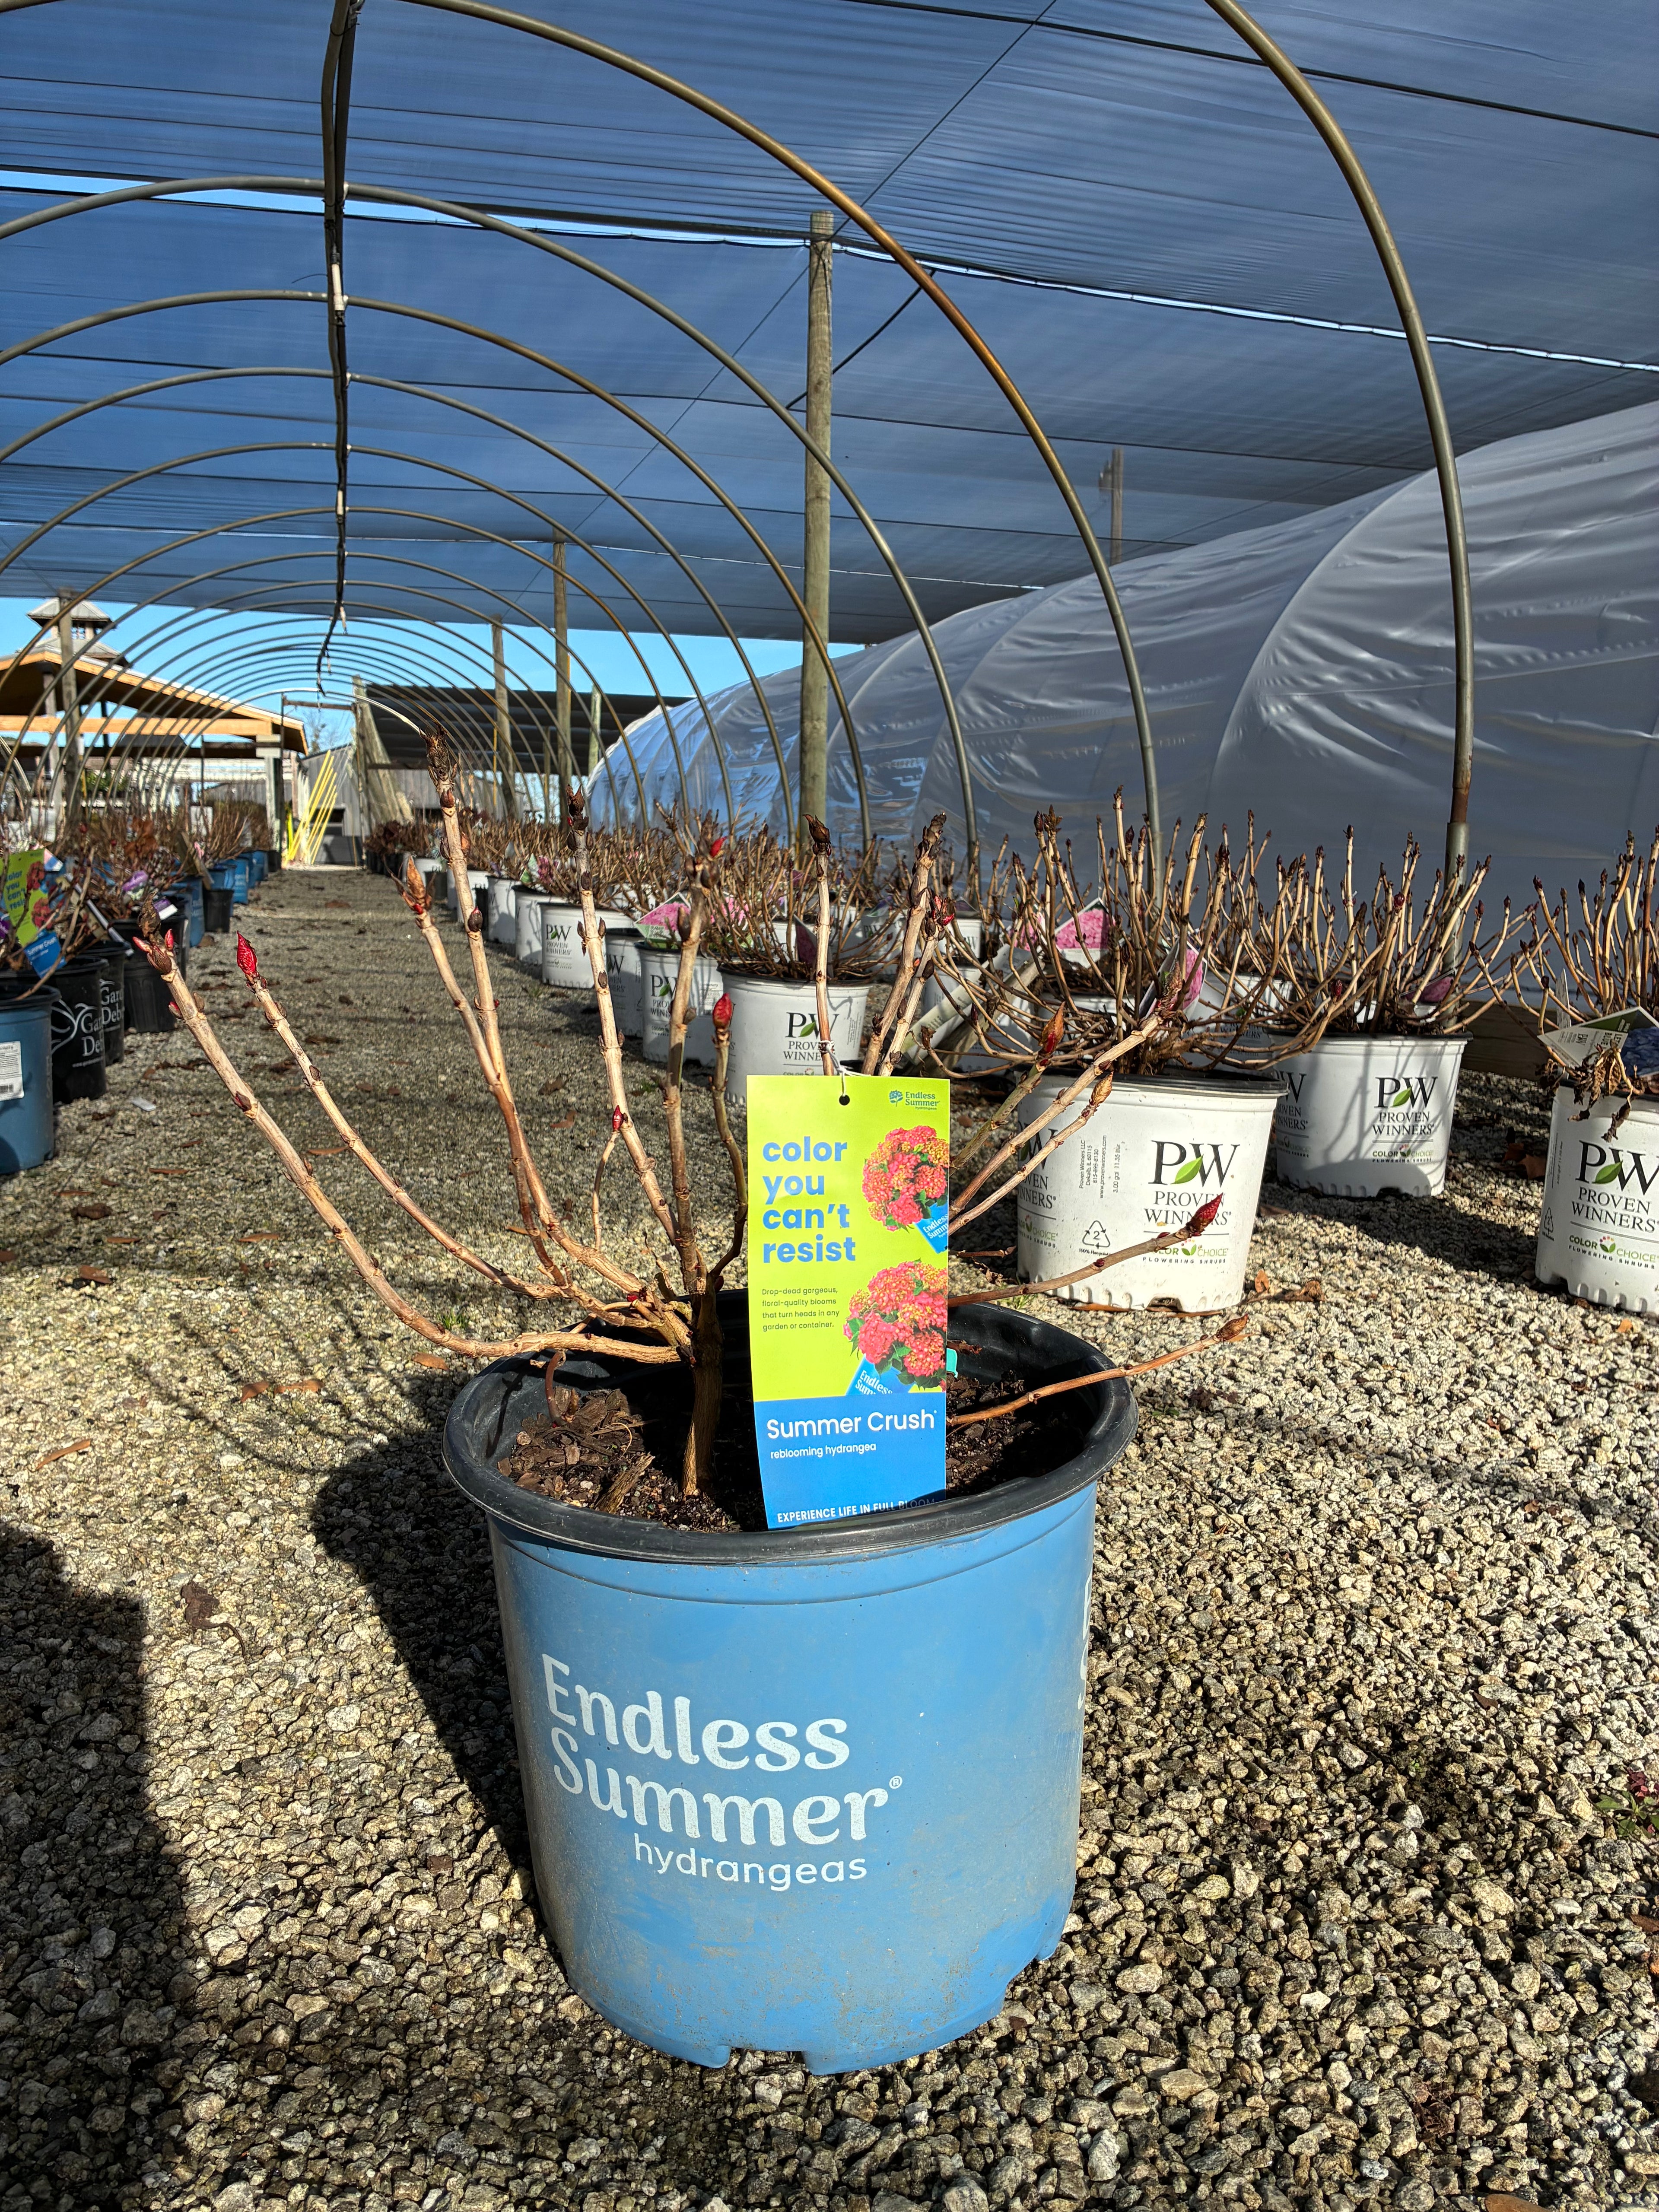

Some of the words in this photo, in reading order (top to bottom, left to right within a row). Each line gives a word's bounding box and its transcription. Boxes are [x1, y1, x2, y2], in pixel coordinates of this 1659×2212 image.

[7, 870, 22, 881] olor
[546, 924, 572, 941] PW
[607, 954, 624, 975] W
[81, 1013, 102, 1034] Gar
[788, 1041, 820, 1050] PROV
[1374, 1076, 1438, 1108] PW
[1379, 1111, 1430, 1123] PROVEN
[763, 1136, 847, 1162] color
[1148, 1140, 1240, 1188] PW
[763, 1175, 824, 1205] you
[1578, 1187, 1652, 1215] PROVEN
[763, 1204, 850, 1230] can't
[1572, 1201, 1656, 1233] WINNERS
[1093, 1231, 1100, 1240] 2
[763, 1234, 856, 1263] resist
[1569, 1235, 1598, 1249] COLOR
[1616, 1248, 1656, 1263] CHOICE
[1569, 1245, 1613, 1261] FLOWERING
[1619, 1259, 1655, 1269] SHRUBS
[762, 1287, 801, 1296] Drop-dead
[762, 1299, 808, 1307] floral-quality
[763, 1323, 788, 1332] garden
[767, 1416, 862, 1439] Summer
[867, 1409, 935, 1431] Crush
[771, 1446, 823, 1459] reblooming
[825, 1442, 876, 1456] hydrangea
[778, 1508, 836, 1523] EXPERIENCE
[839, 1505, 857, 1516] LIFE
[860, 1504, 871, 1513] IN
[873, 1502, 896, 1512] FULL
[542, 1653, 850, 1772] Endless
[635, 1832, 867, 1891] hydrangeas
